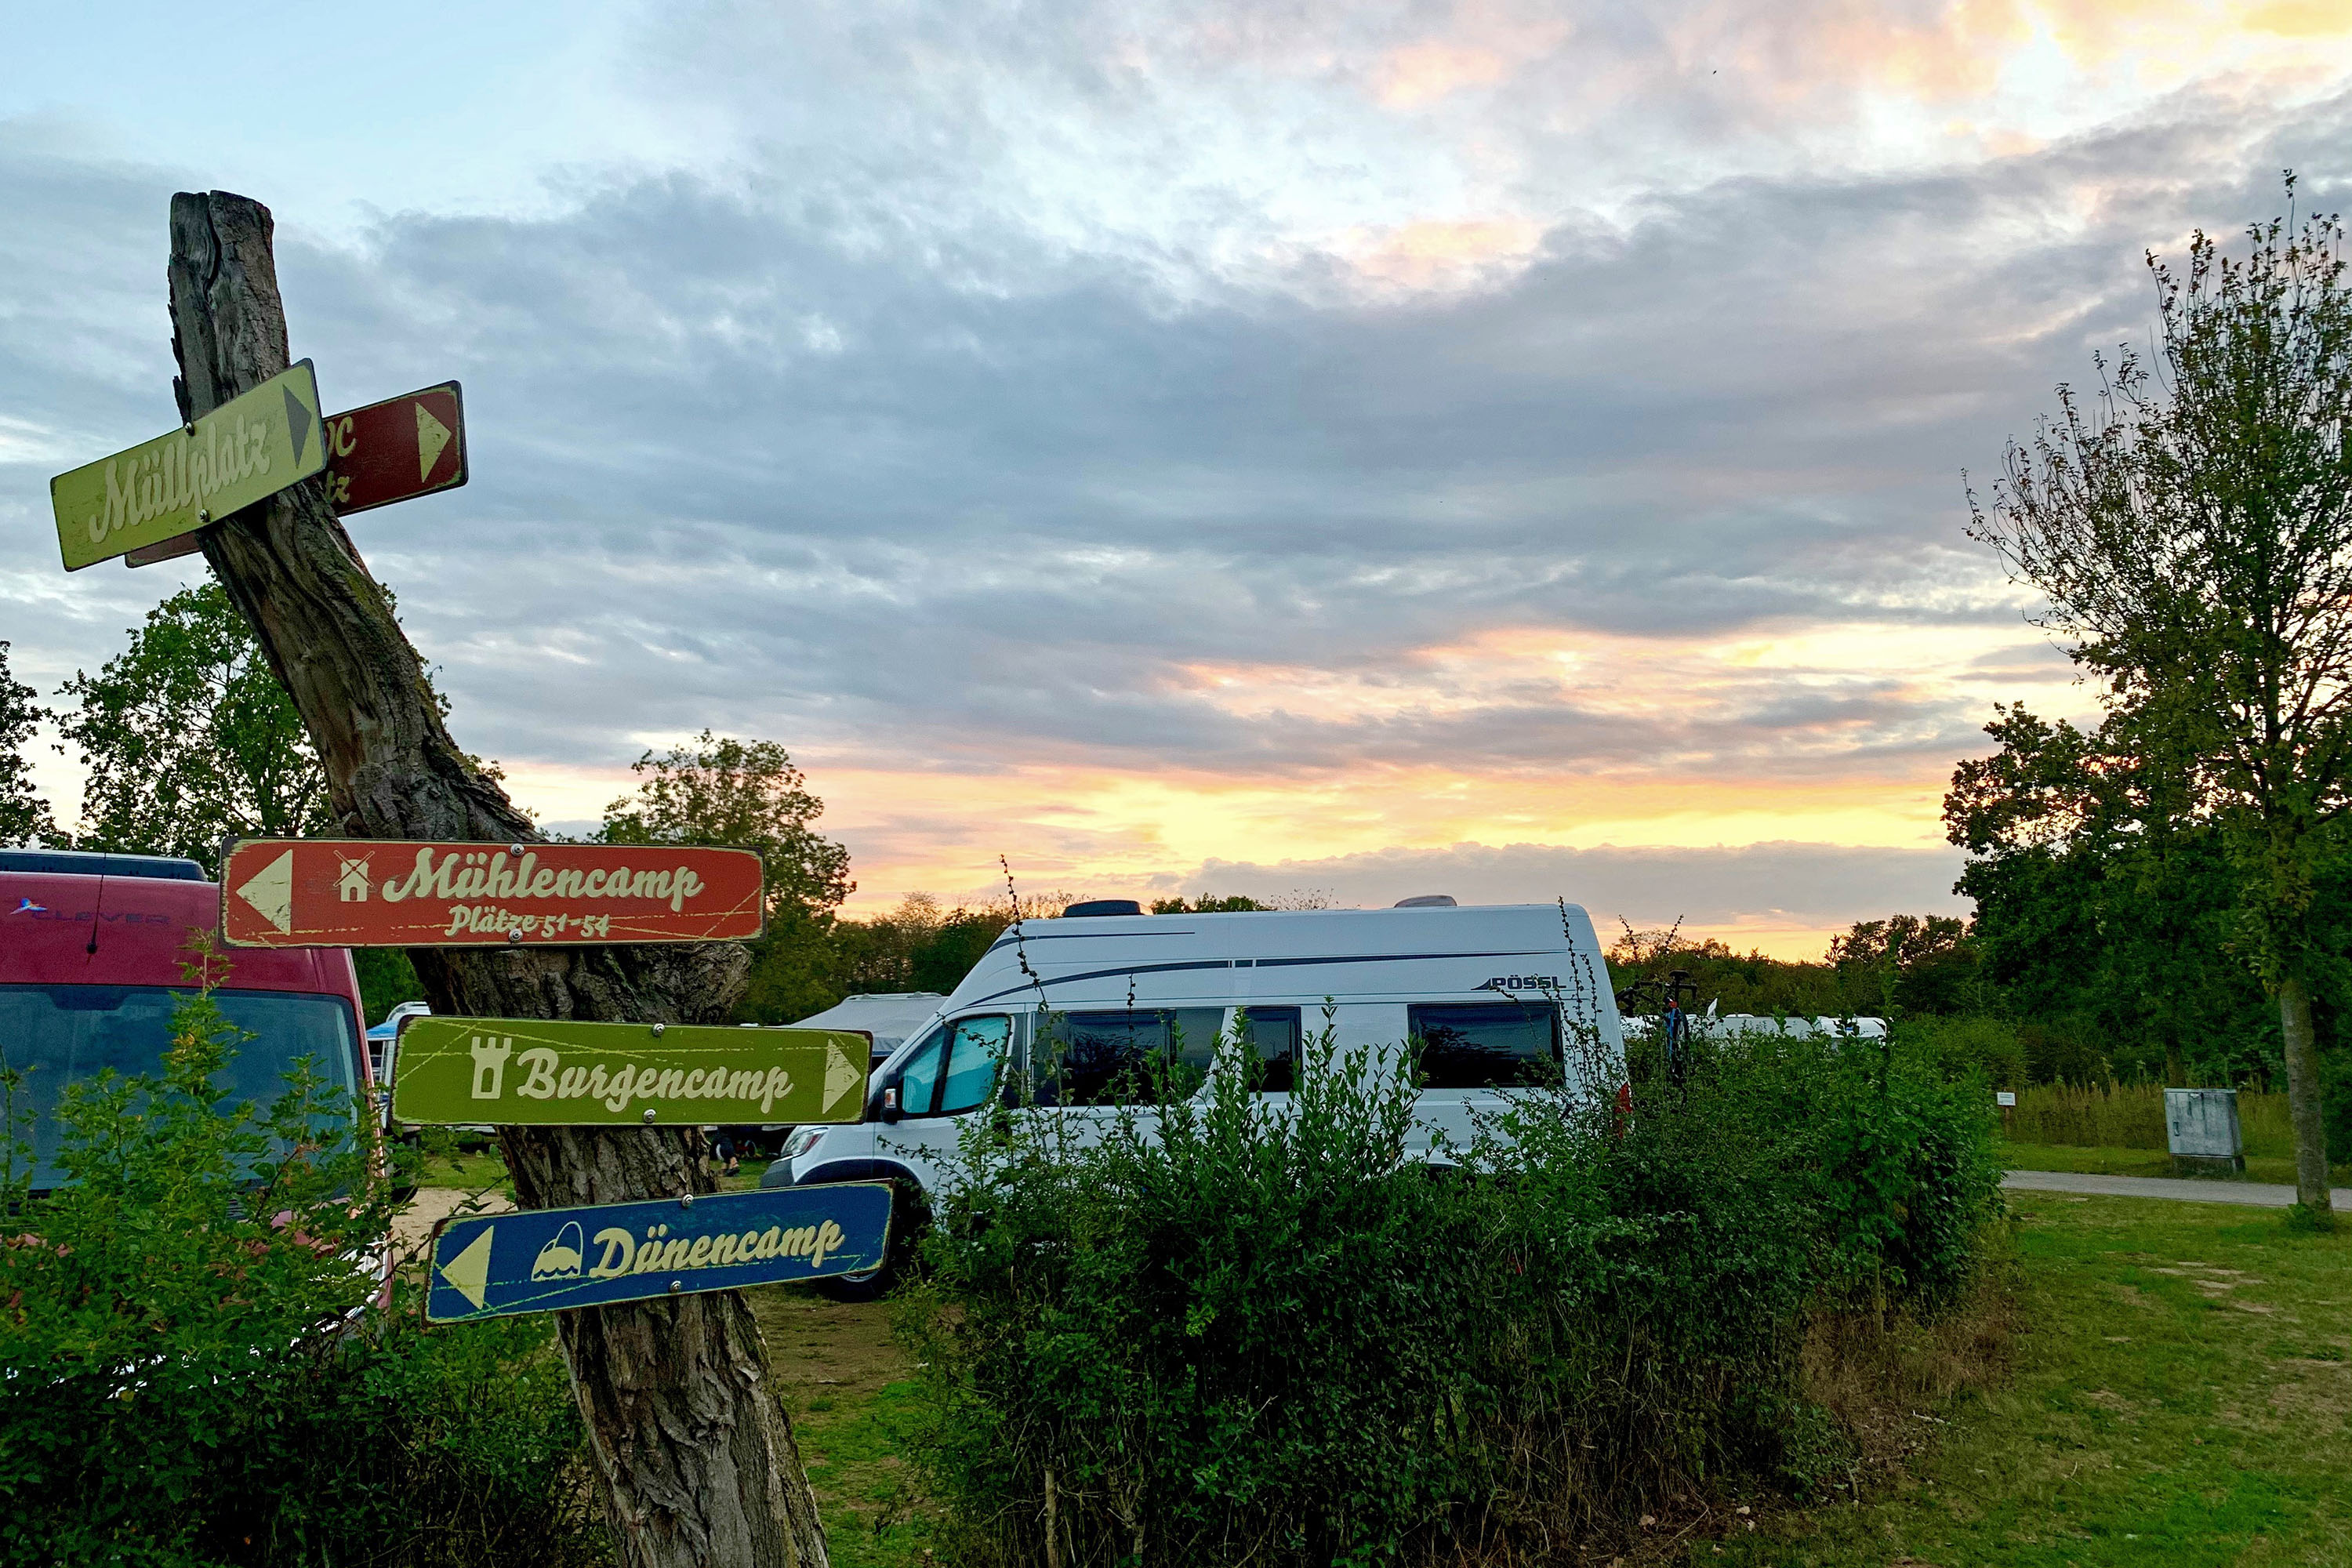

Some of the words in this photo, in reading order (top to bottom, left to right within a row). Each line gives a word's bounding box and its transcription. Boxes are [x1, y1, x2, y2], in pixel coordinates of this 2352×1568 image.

[89, 413, 270, 543] Müllplatz
[383, 847, 705, 912] Mühlencamp
[444, 904, 538, 937] Plätze
[541, 913, 609, 938] 51-54
[1491, 975, 1566, 990] PÖSSL
[517, 1048, 793, 1114] Burgencamp
[589, 1220, 845, 1278] Dünencamp
